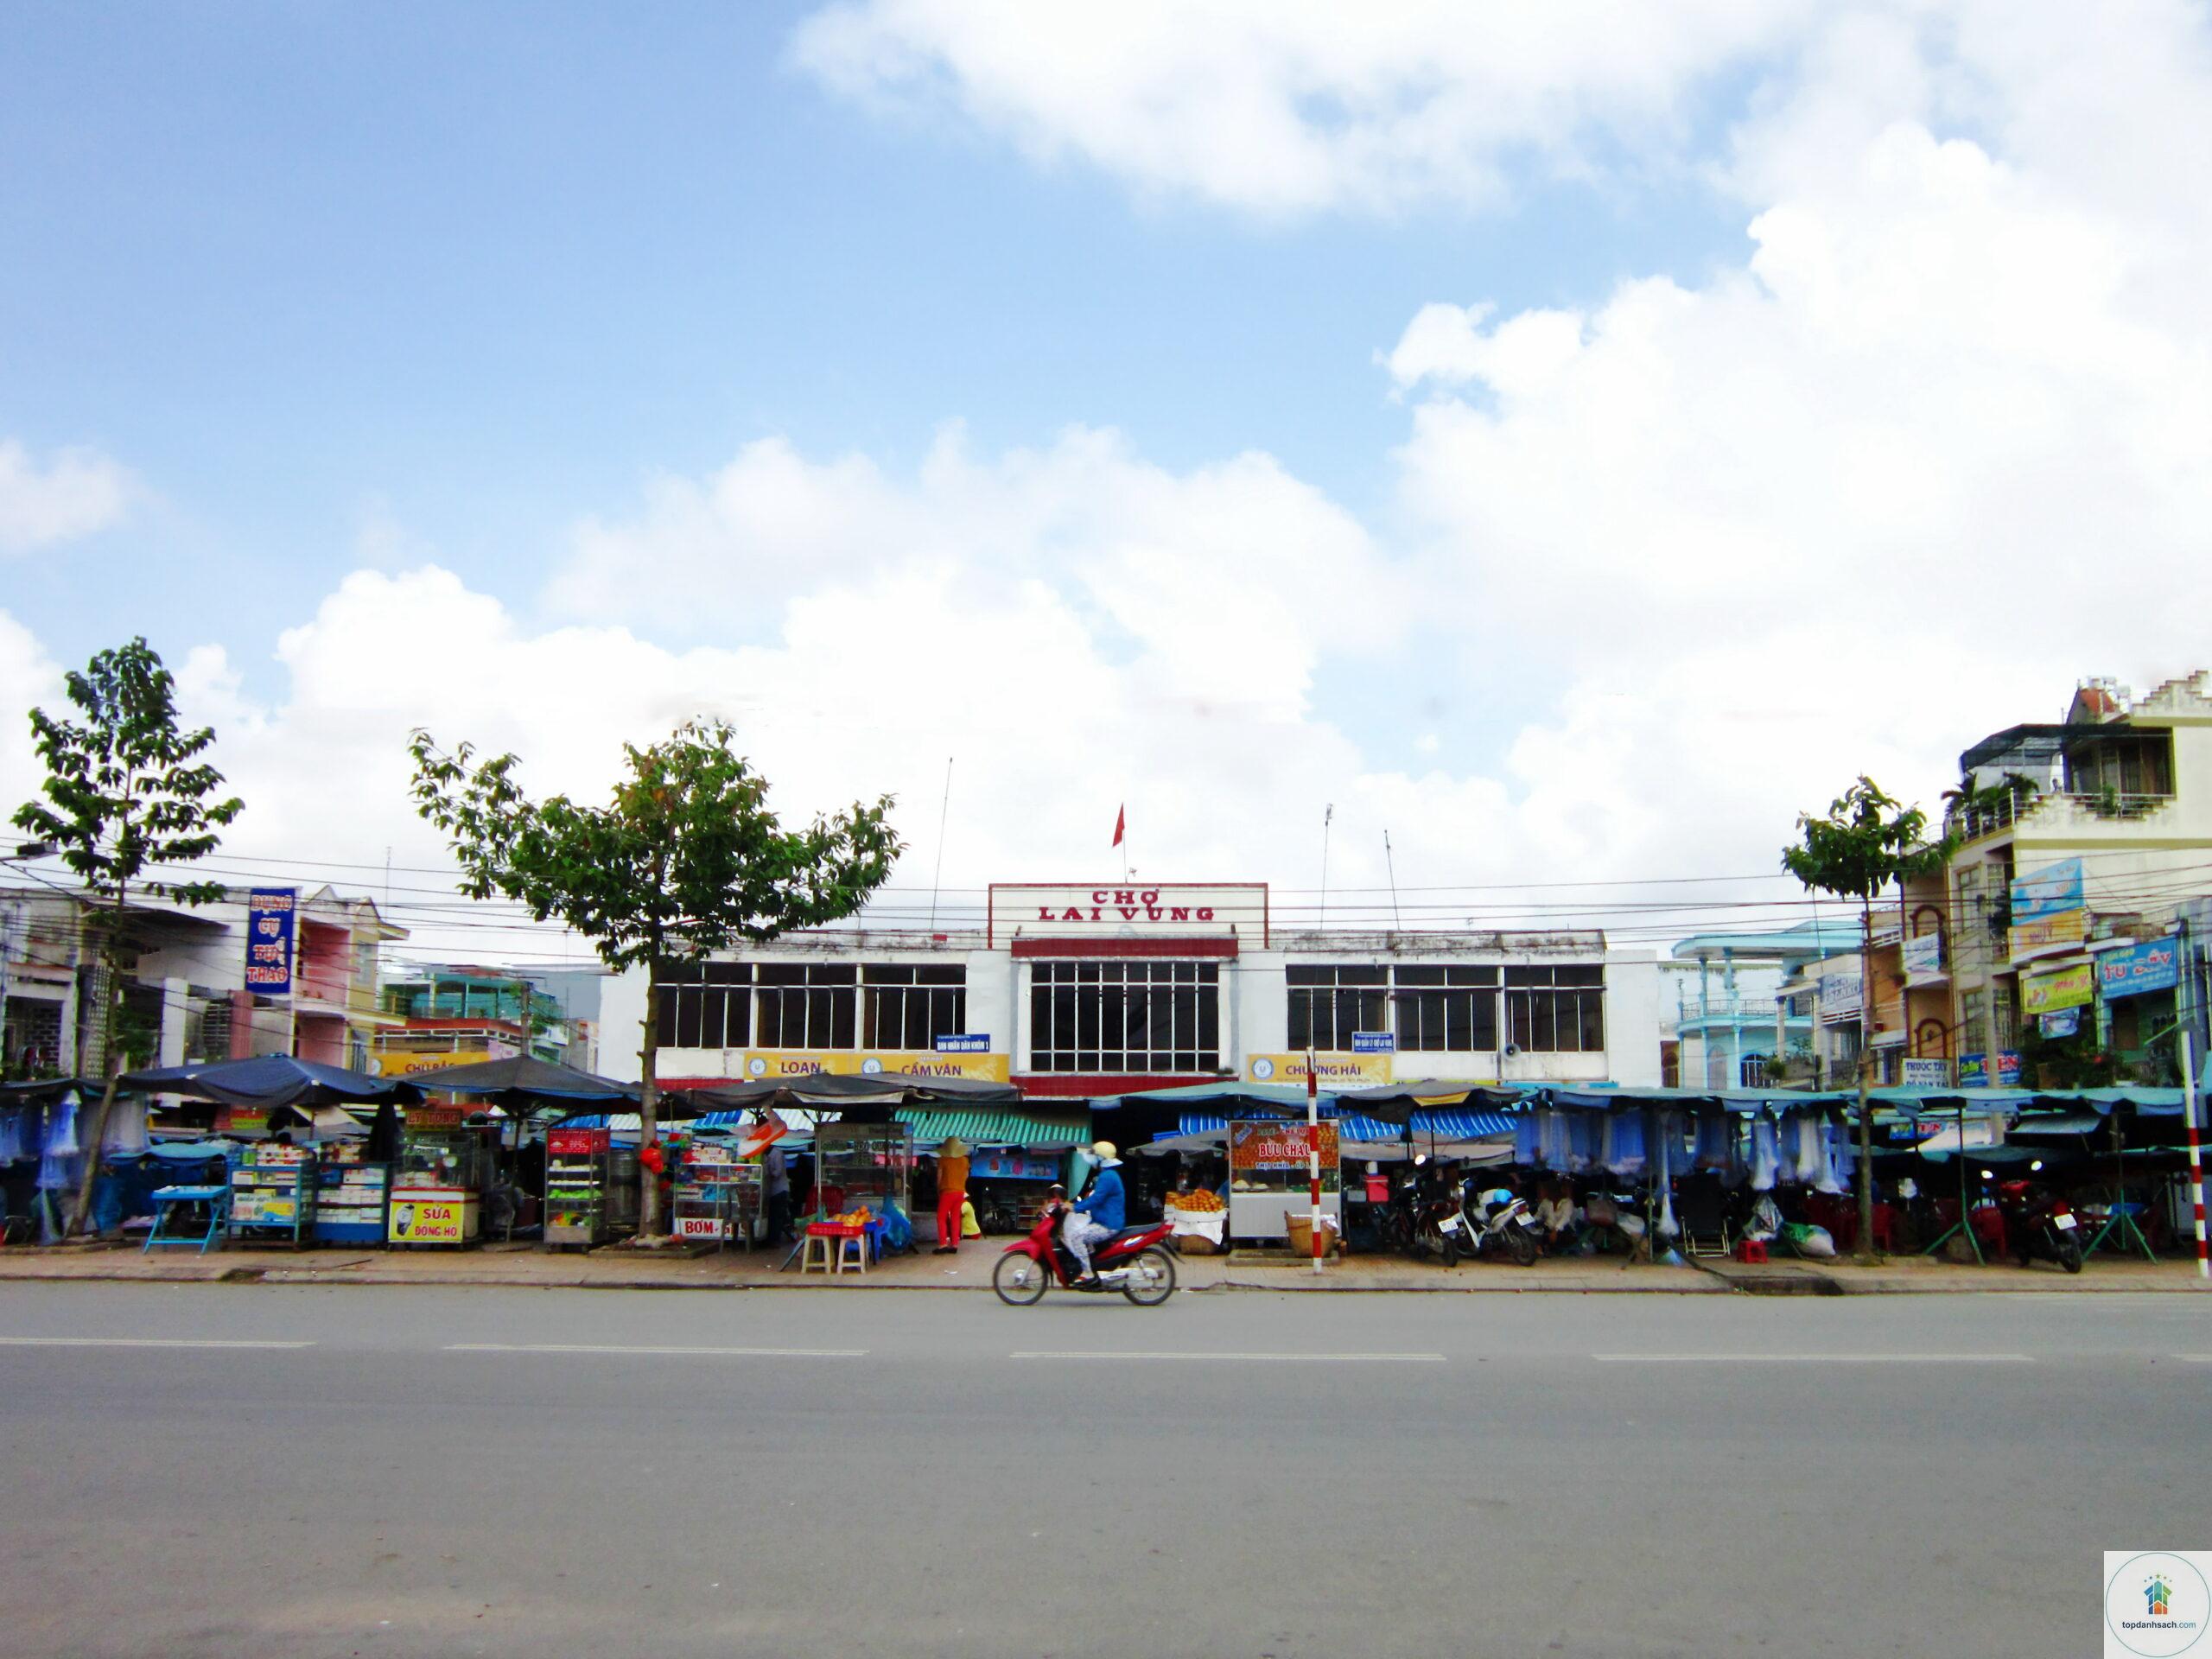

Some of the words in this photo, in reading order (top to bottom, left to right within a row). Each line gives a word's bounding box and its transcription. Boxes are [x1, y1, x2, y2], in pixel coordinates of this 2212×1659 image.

[1092, 888, 1160, 907] CHỢ
[1039, 907, 1102, 920] LAI
[781, 1062, 821, 1073] LOAN
[935, 1064, 962, 1076] VÂN
